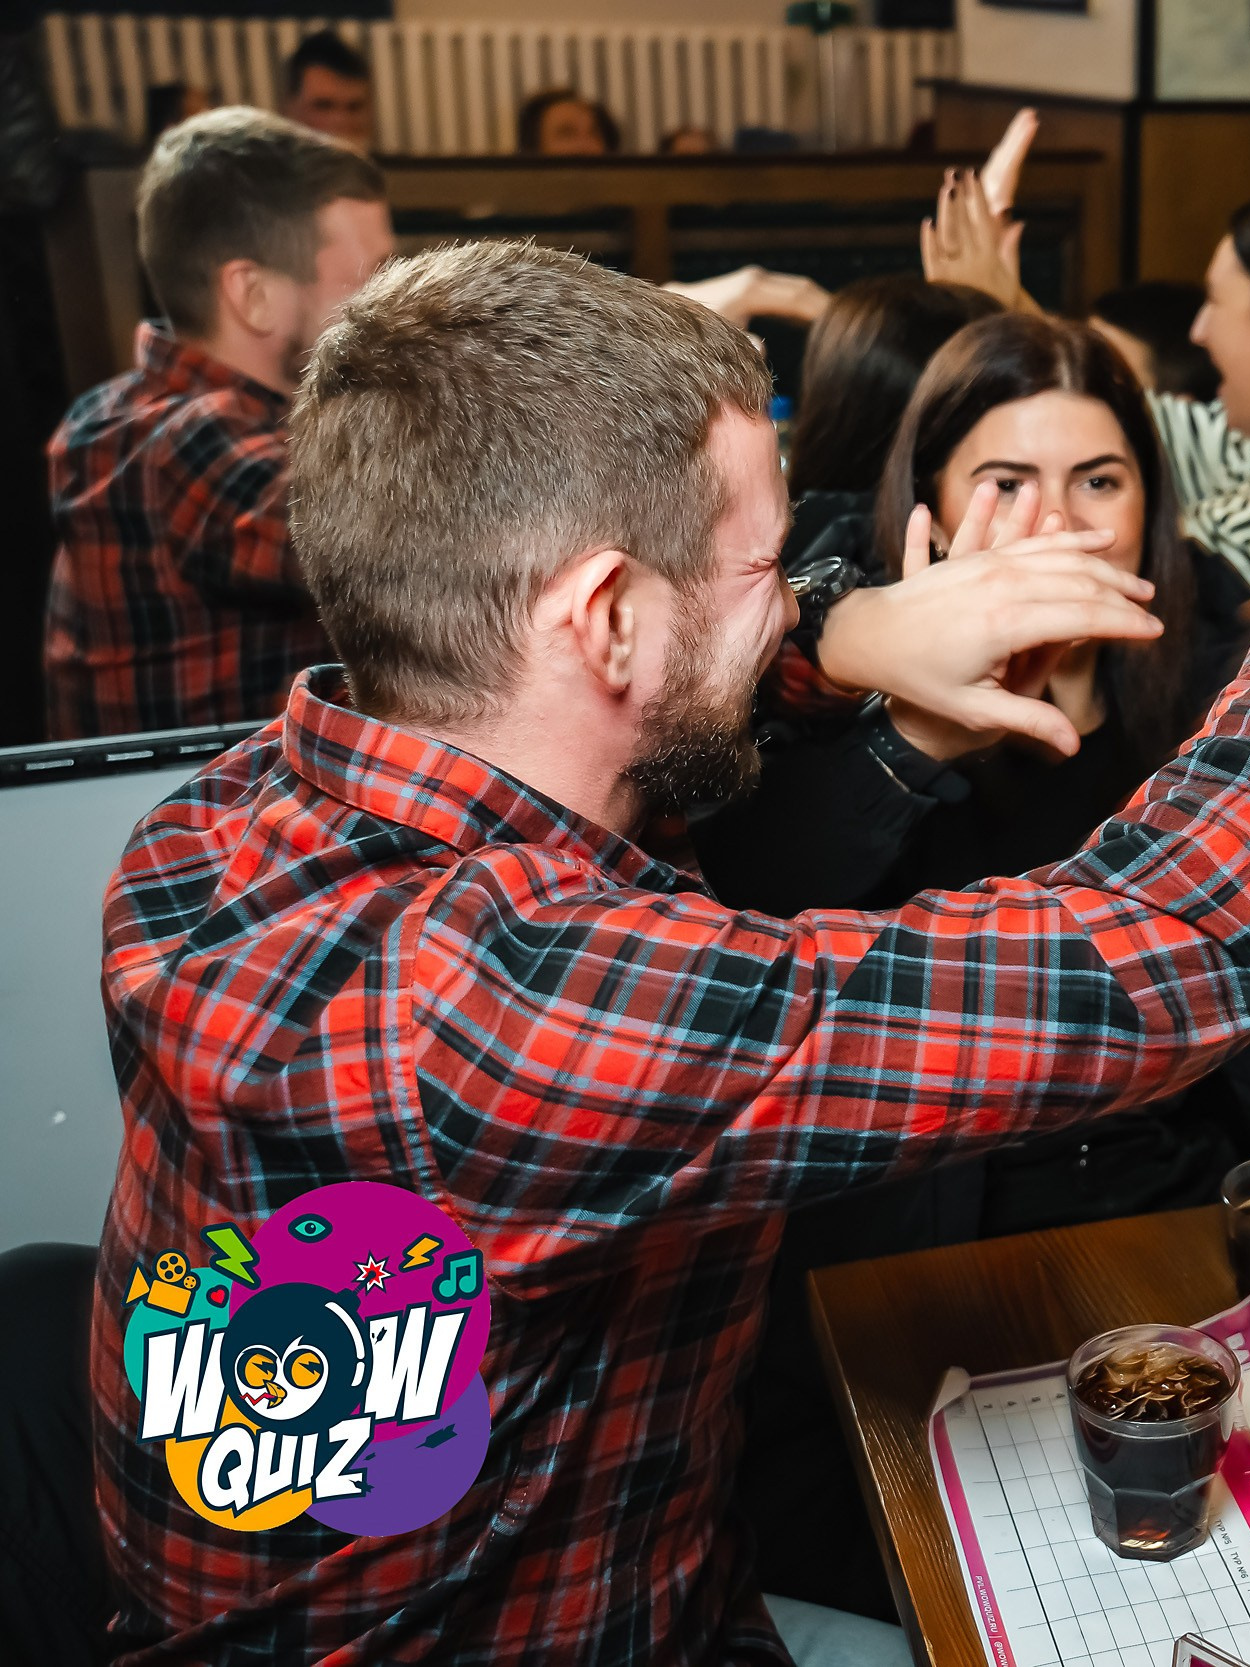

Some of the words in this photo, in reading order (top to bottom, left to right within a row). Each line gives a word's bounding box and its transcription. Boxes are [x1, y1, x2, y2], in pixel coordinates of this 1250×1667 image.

[1216, 1520, 1226, 1533] ТУР
[1230, 1551, 1242, 1566] ТУР
[994, 1641, 1008, 1667] @WOW
